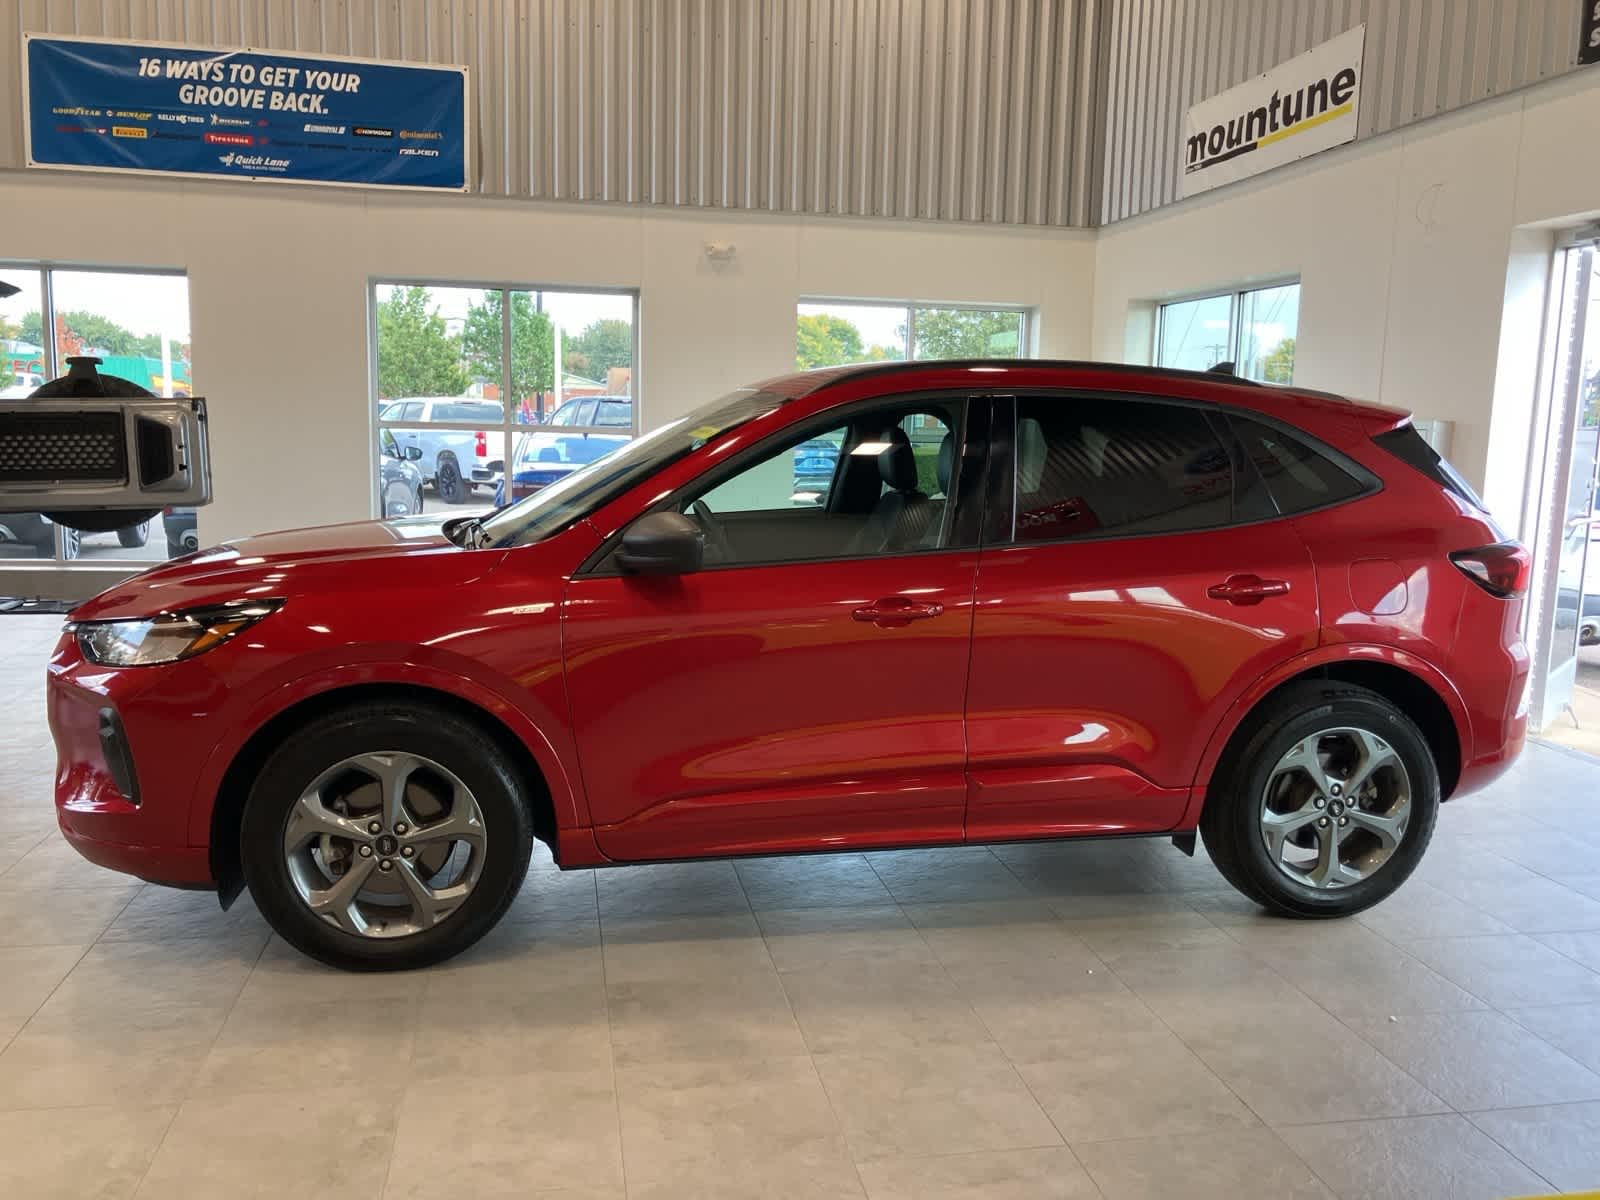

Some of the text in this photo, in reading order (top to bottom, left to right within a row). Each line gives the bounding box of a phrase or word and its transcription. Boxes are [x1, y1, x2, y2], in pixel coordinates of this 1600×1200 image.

[138, 57, 361, 93] 16 WAYS TO GET YOUR
[179, 84, 329, 115] GROOVE BACK.
[1186, 67, 1356, 165] mountune
[234, 154, 290, 167] Quick Lane
[400, 148, 439, 157] FALKEN
